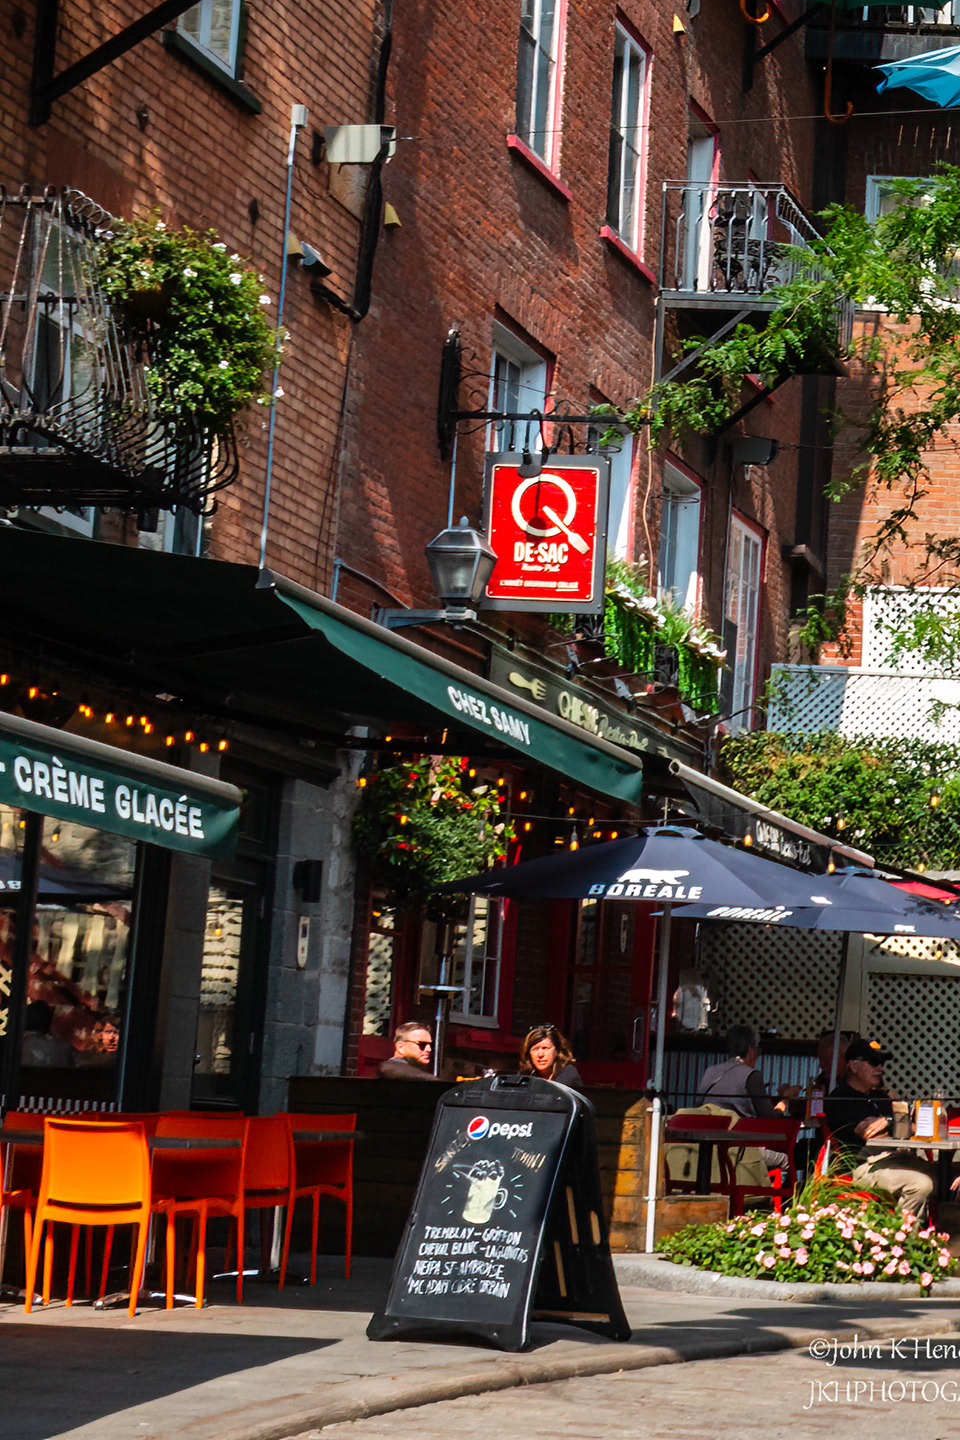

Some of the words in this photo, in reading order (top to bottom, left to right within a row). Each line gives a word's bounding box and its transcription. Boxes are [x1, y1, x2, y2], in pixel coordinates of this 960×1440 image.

[446, 685, 491, 725] CHEZ
[490, 705, 531, 746] SAMY
[14, 755, 106, 813] CRÈME
[115, 784, 205, 839] GLACÉE
[488, 1122, 534, 1140] pepsi
